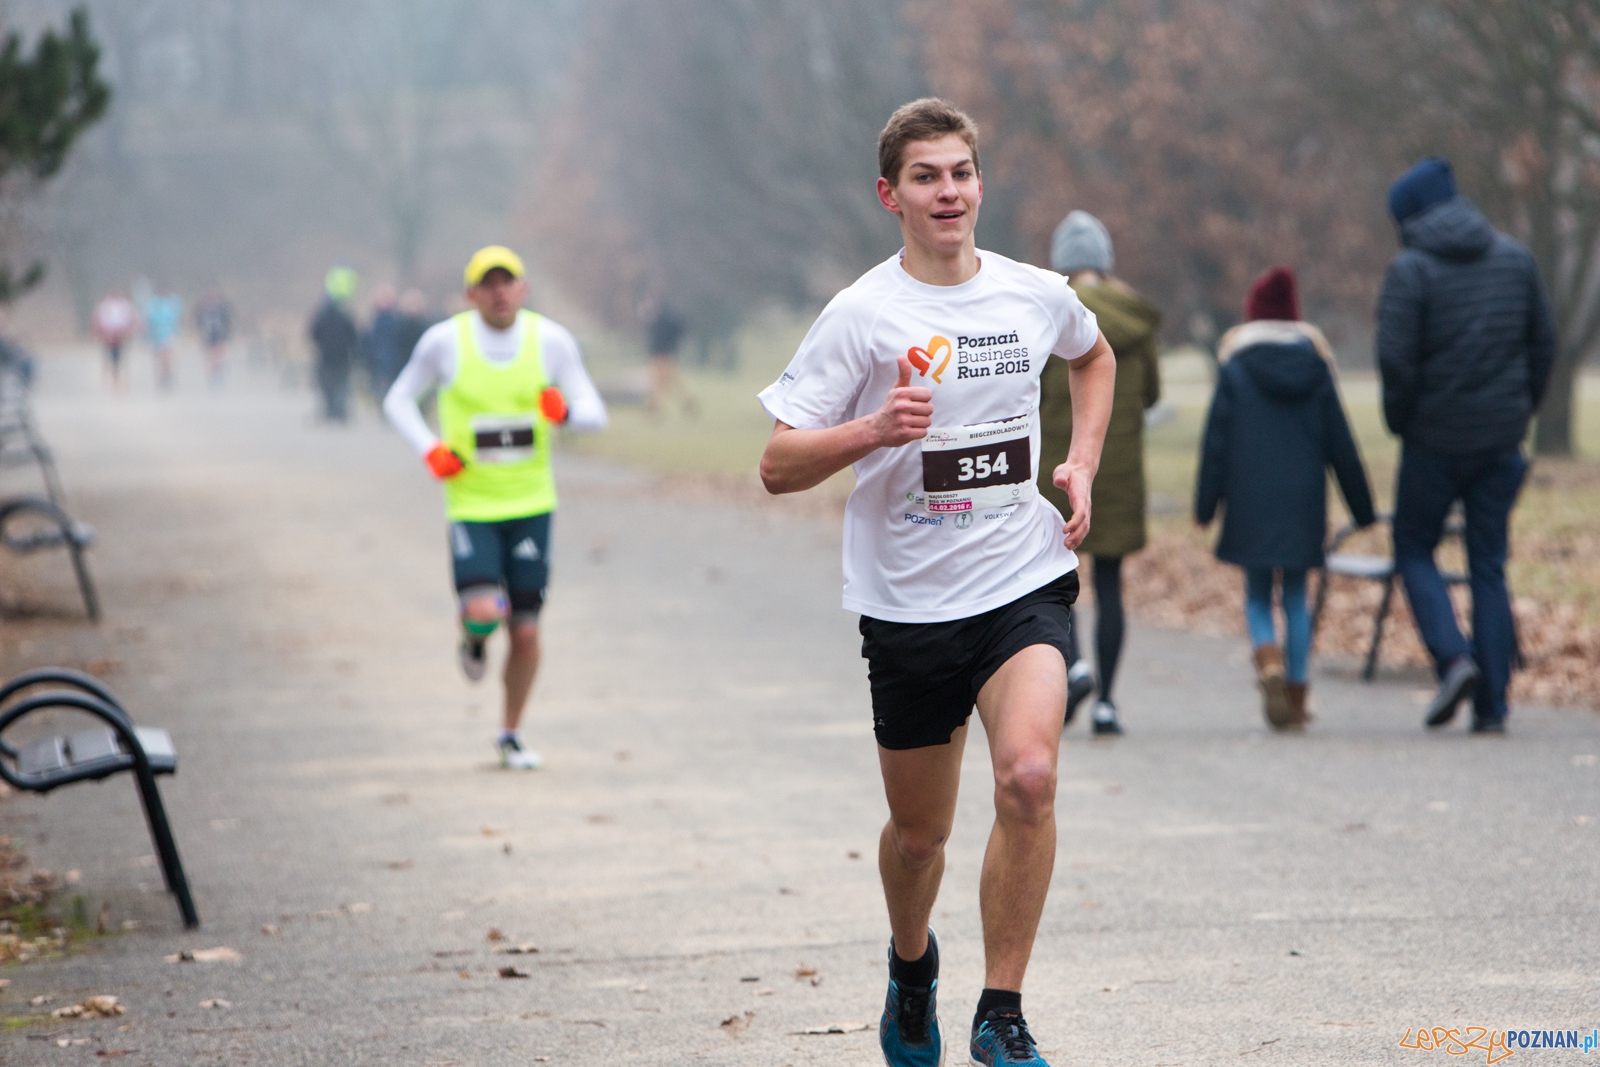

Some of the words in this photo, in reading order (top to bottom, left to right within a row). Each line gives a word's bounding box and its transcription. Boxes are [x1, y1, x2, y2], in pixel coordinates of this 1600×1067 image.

[957, 330, 1019, 349] Poznań
[957, 347, 1029, 364] Business
[957, 365, 991, 379] Run
[994, 359, 1030, 375] 2015
[957, 451, 1010, 482] 354
[929, 503, 965, 511] 14.02.2016
